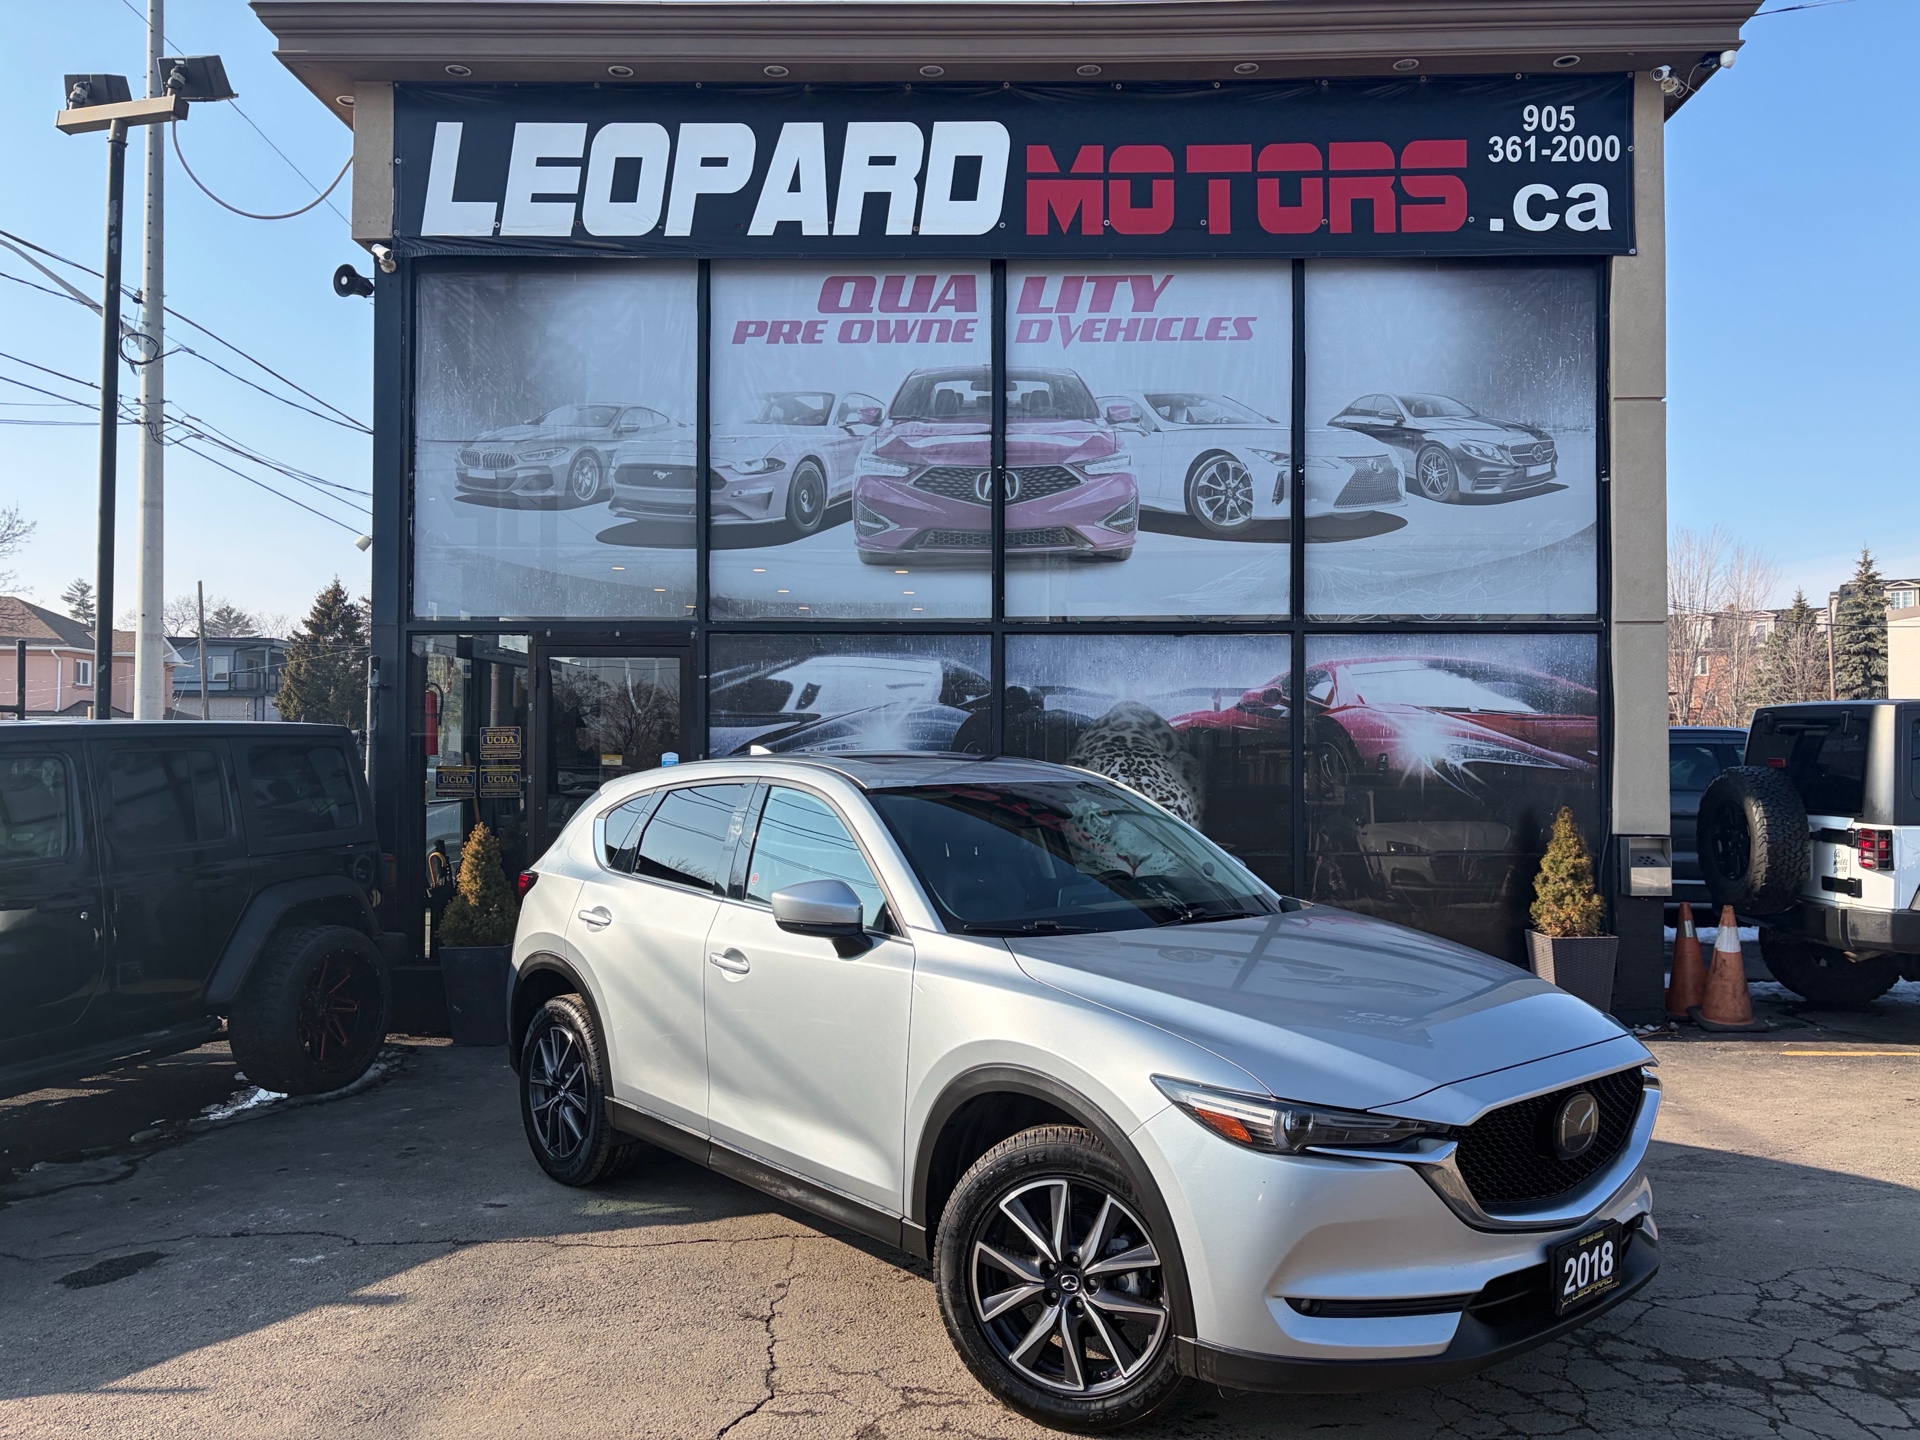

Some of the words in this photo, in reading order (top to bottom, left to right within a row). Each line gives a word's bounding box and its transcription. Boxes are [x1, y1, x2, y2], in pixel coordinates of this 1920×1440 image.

[1523, 105, 1576, 132] 905
[1488, 135, 1621, 162] 361-2000
[421, 121, 1010, 236] LEOPARD
[1026, 140, 1467, 236] MOTORS
[1489, 183, 1612, 231] .ca
[732, 320, 828, 344] PRE
[486, 736, 515, 744] UCDA
[442, 776, 469, 784] UCDA
[487, 775, 514, 783] UCDA
[1564, 1240, 1613, 1295] 2018
[1572, 1276, 1613, 1300] LEOPARD
